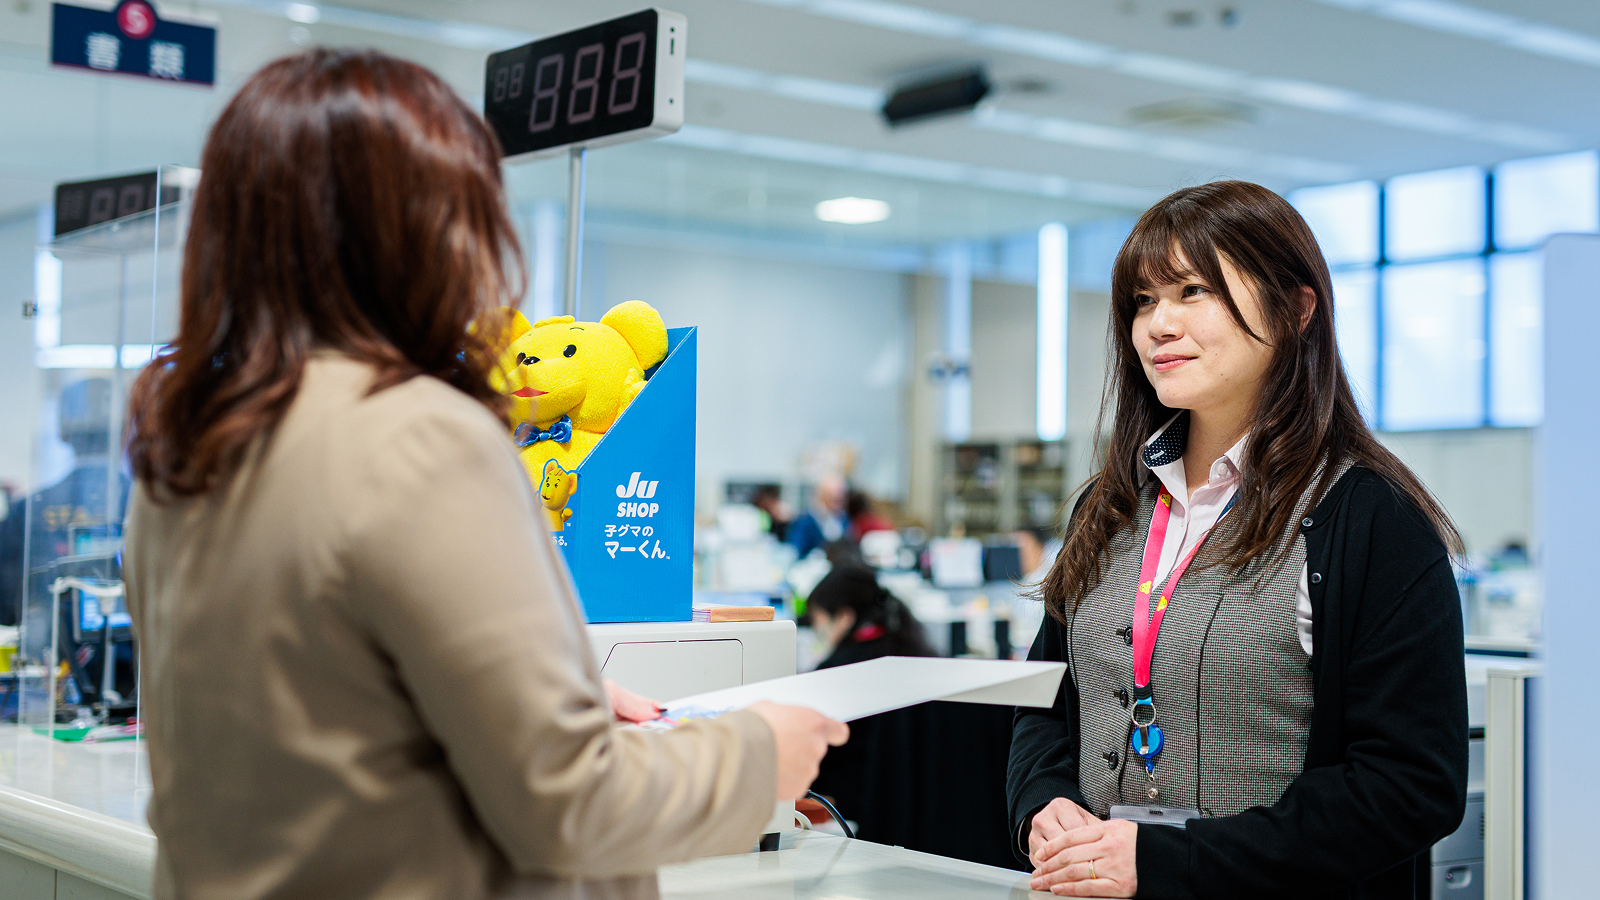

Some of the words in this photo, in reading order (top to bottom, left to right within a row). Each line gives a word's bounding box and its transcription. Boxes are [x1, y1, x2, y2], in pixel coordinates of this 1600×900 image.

[616, 502, 659, 518] SHOP
[604, 524, 654, 537] 子グマの
[604, 539, 666, 559] マーくん
